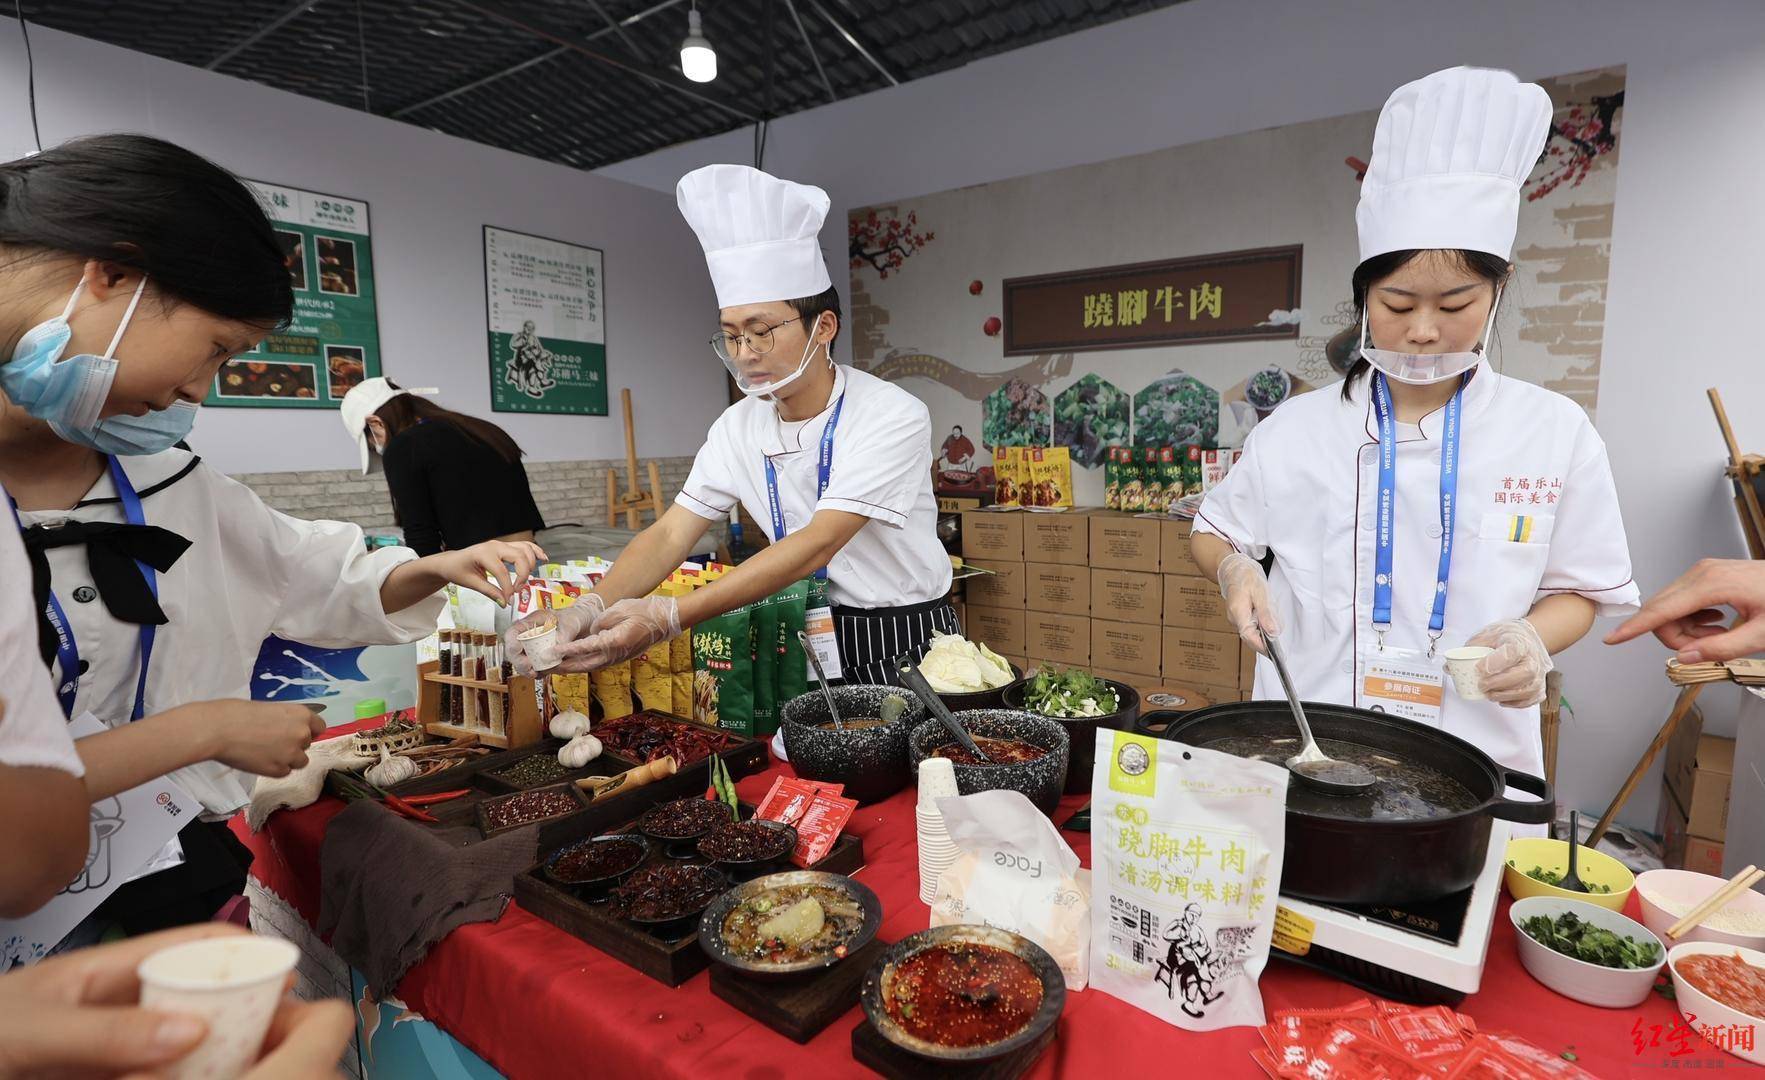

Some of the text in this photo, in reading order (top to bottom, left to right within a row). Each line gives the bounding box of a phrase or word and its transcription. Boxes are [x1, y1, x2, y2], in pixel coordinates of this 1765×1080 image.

[1382, 415, 1390, 435] CHINA
[1445, 441, 1454, 474] WESTERN
[1502, 477, 1562, 490] 首届乐山
[994, 851, 1042, 878] Face
[1117, 826, 1246, 875] 跷脚牛肉
[1119, 861, 1244, 906] 清汤调味料
